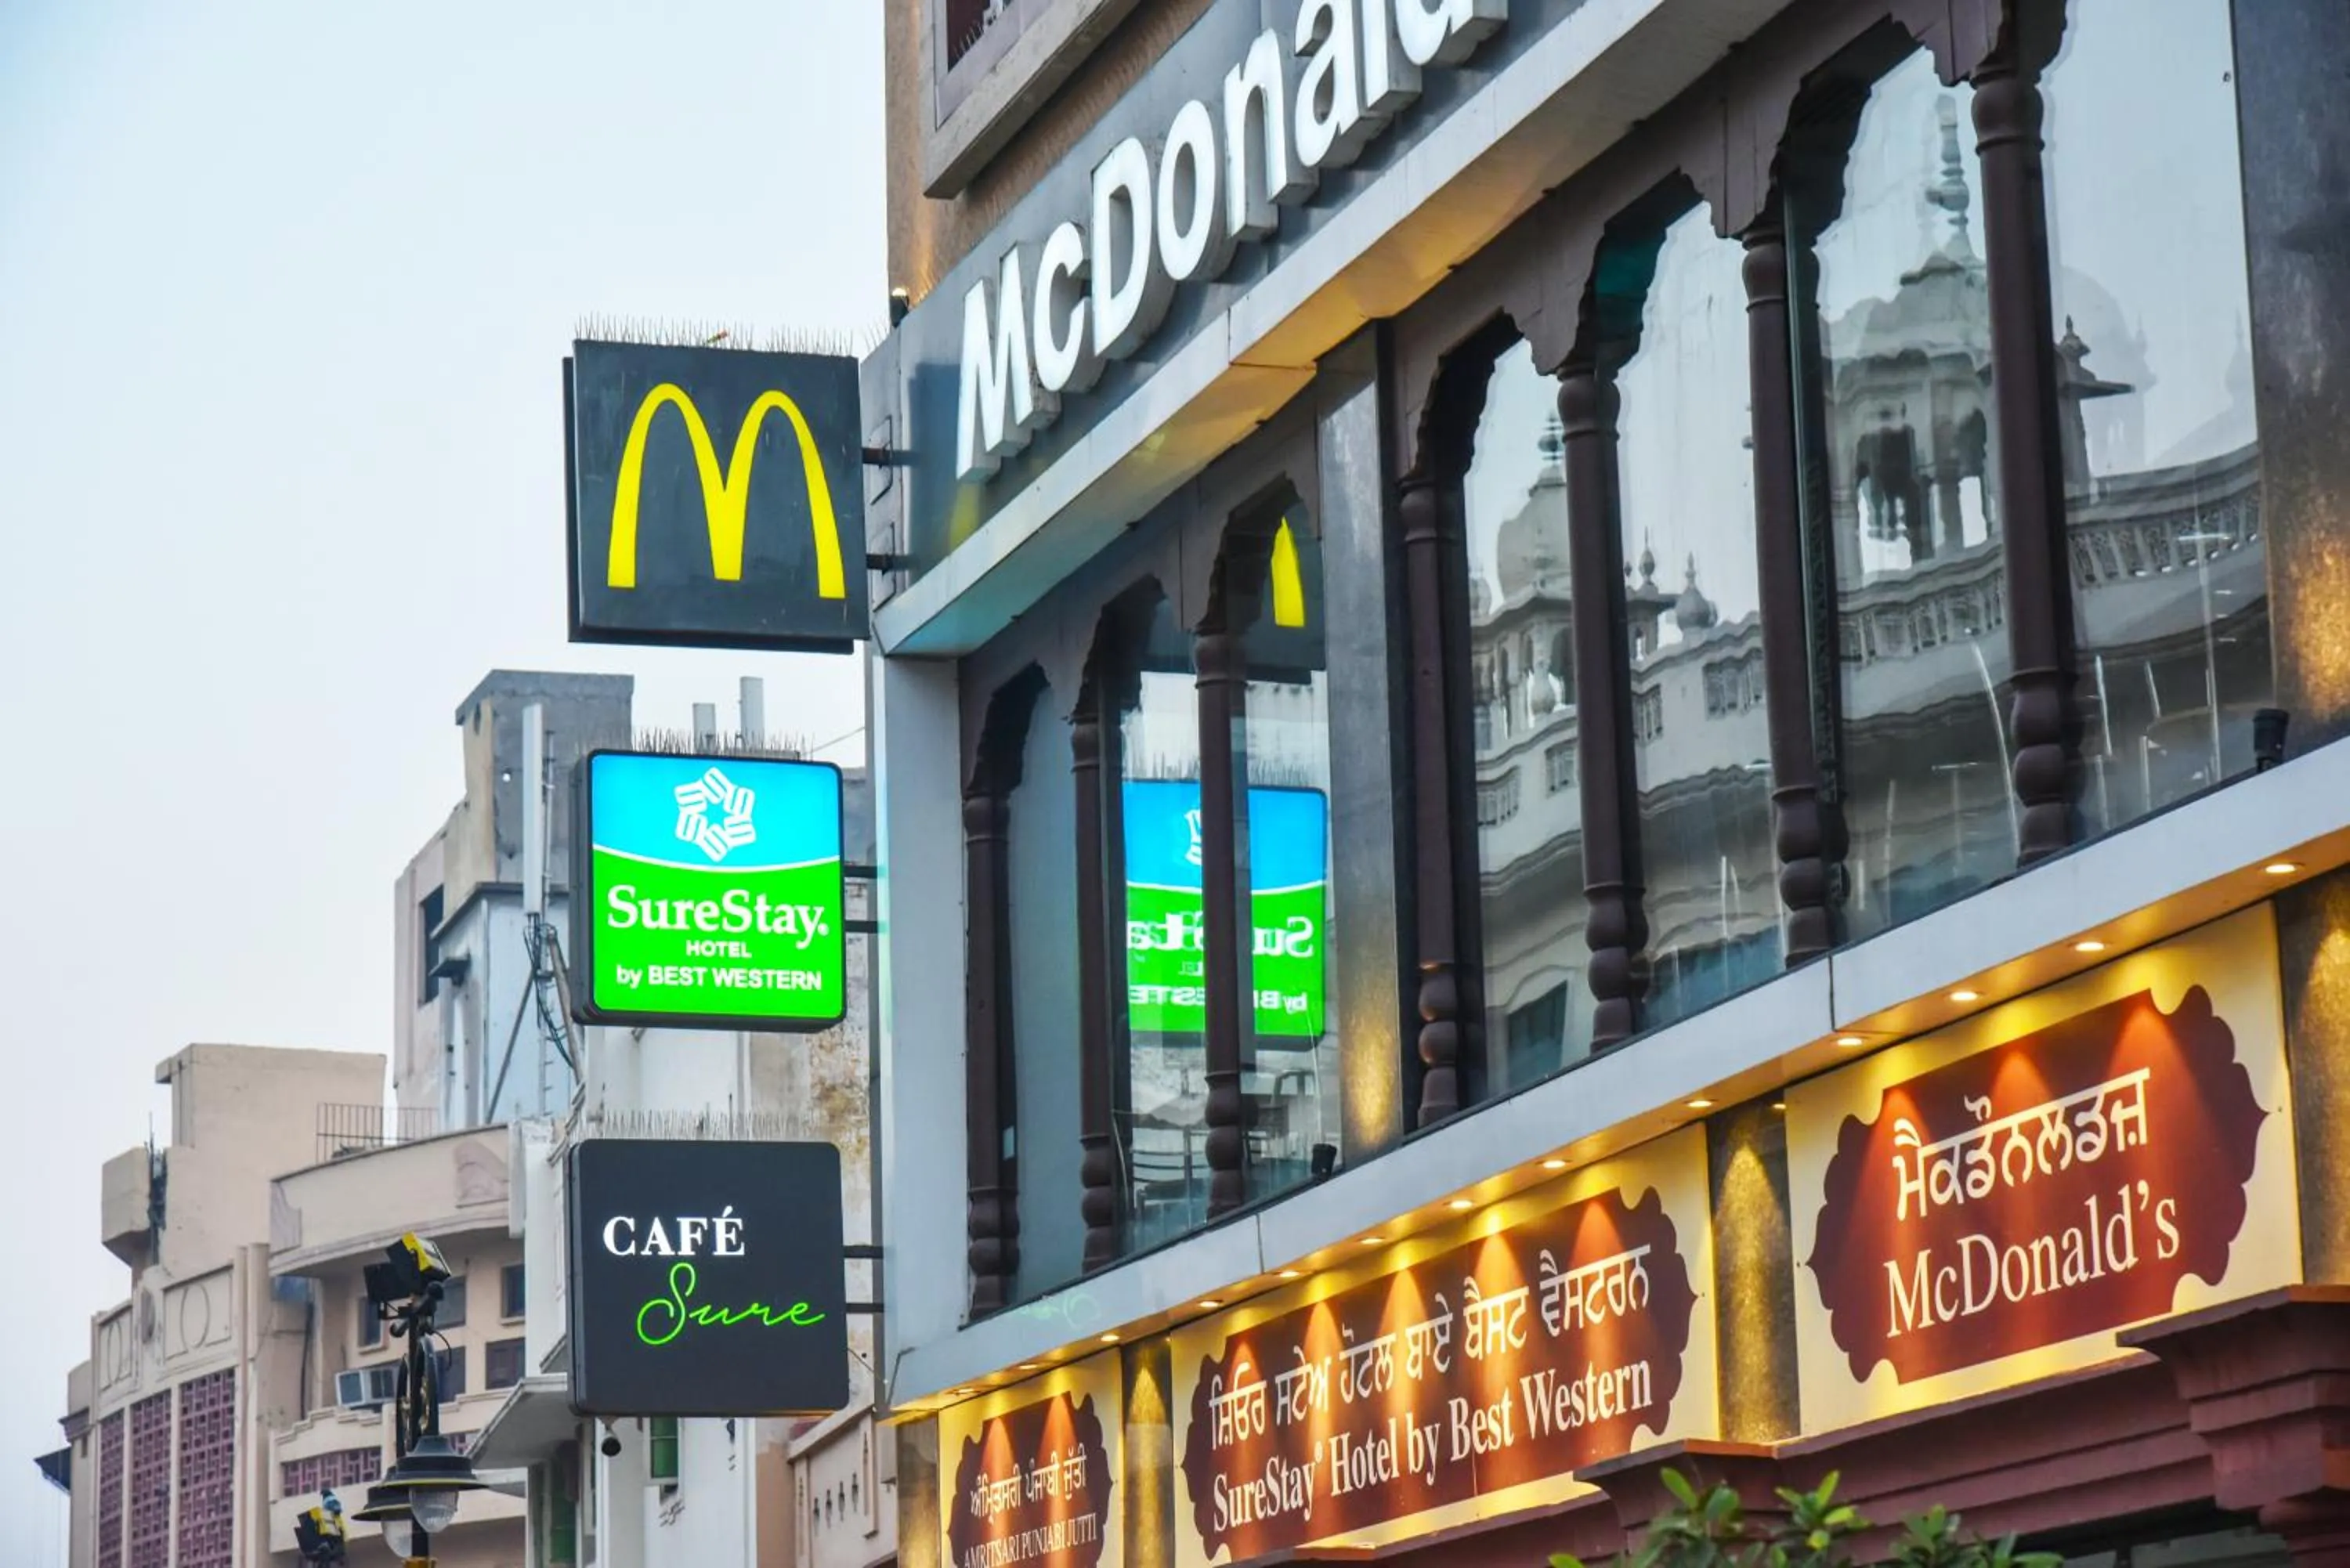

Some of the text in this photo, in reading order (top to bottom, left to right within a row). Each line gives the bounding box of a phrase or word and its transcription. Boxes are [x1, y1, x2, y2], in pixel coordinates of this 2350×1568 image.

[956, 0, 1488, 479] McDona
[616, 965, 822, 991] by BEST WESTERN
[685, 940, 752, 959] HOTEL
[602, 1205, 745, 1256] CAFÉ
[1883, 1179, 2180, 1339] McDonald's
[637, 1262, 825, 1346] Sure
[1338, 1323, 1397, 1404] ਹੋਟਲ
[1462, 1276, 1530, 1360] ਬੈਸਟ
[1539, 1242, 1651, 1338] ਵੈਸਟਰਨ
[1329, 1417, 1401, 1497] Hotel
[1406, 1411, 1441, 1487] by
[1448, 1386, 1514, 1462] Best
[1519, 1360, 1653, 1440] Western
[964, 1512, 1097, 1568] AMRITSARI PUNJABI JUTTI
